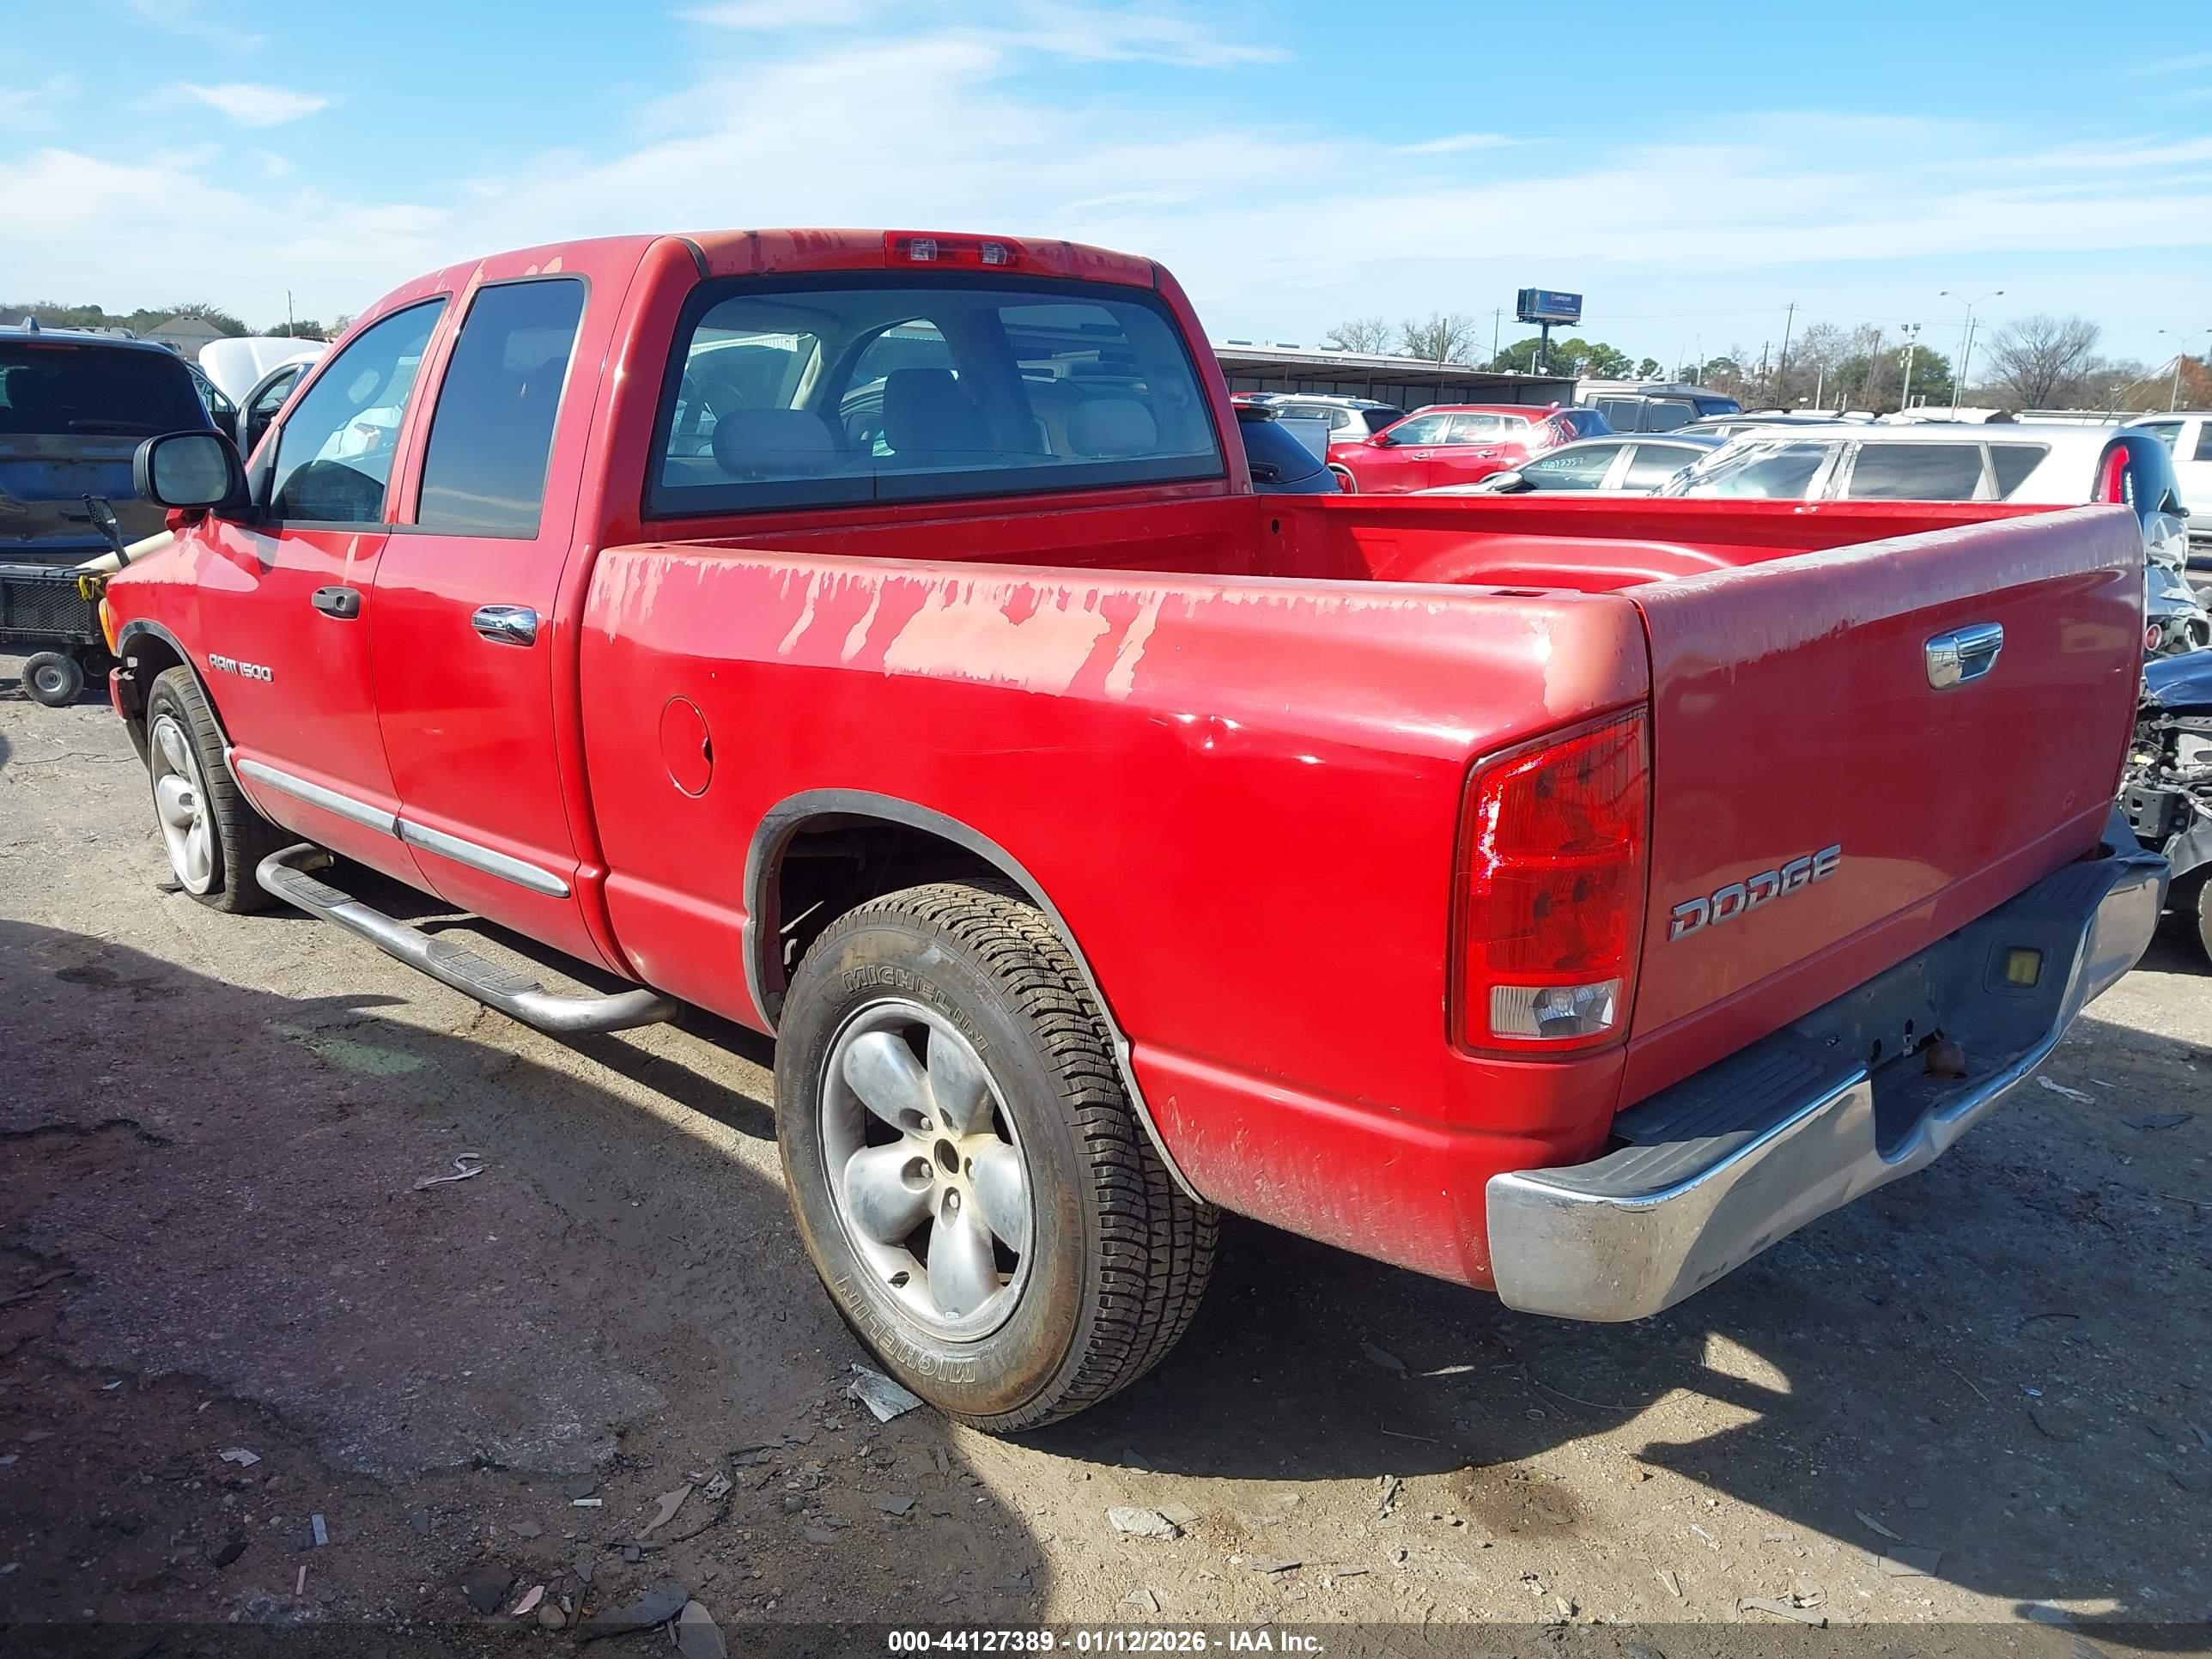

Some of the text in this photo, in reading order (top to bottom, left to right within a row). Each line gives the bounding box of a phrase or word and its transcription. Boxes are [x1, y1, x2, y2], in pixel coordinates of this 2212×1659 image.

[209, 653, 274, 682] RAM 1500
[1668, 844, 1841, 942] DODGE
[842, 964, 994, 1054] MICHELIN
[835, 1273, 976, 1384] MICHELIN
